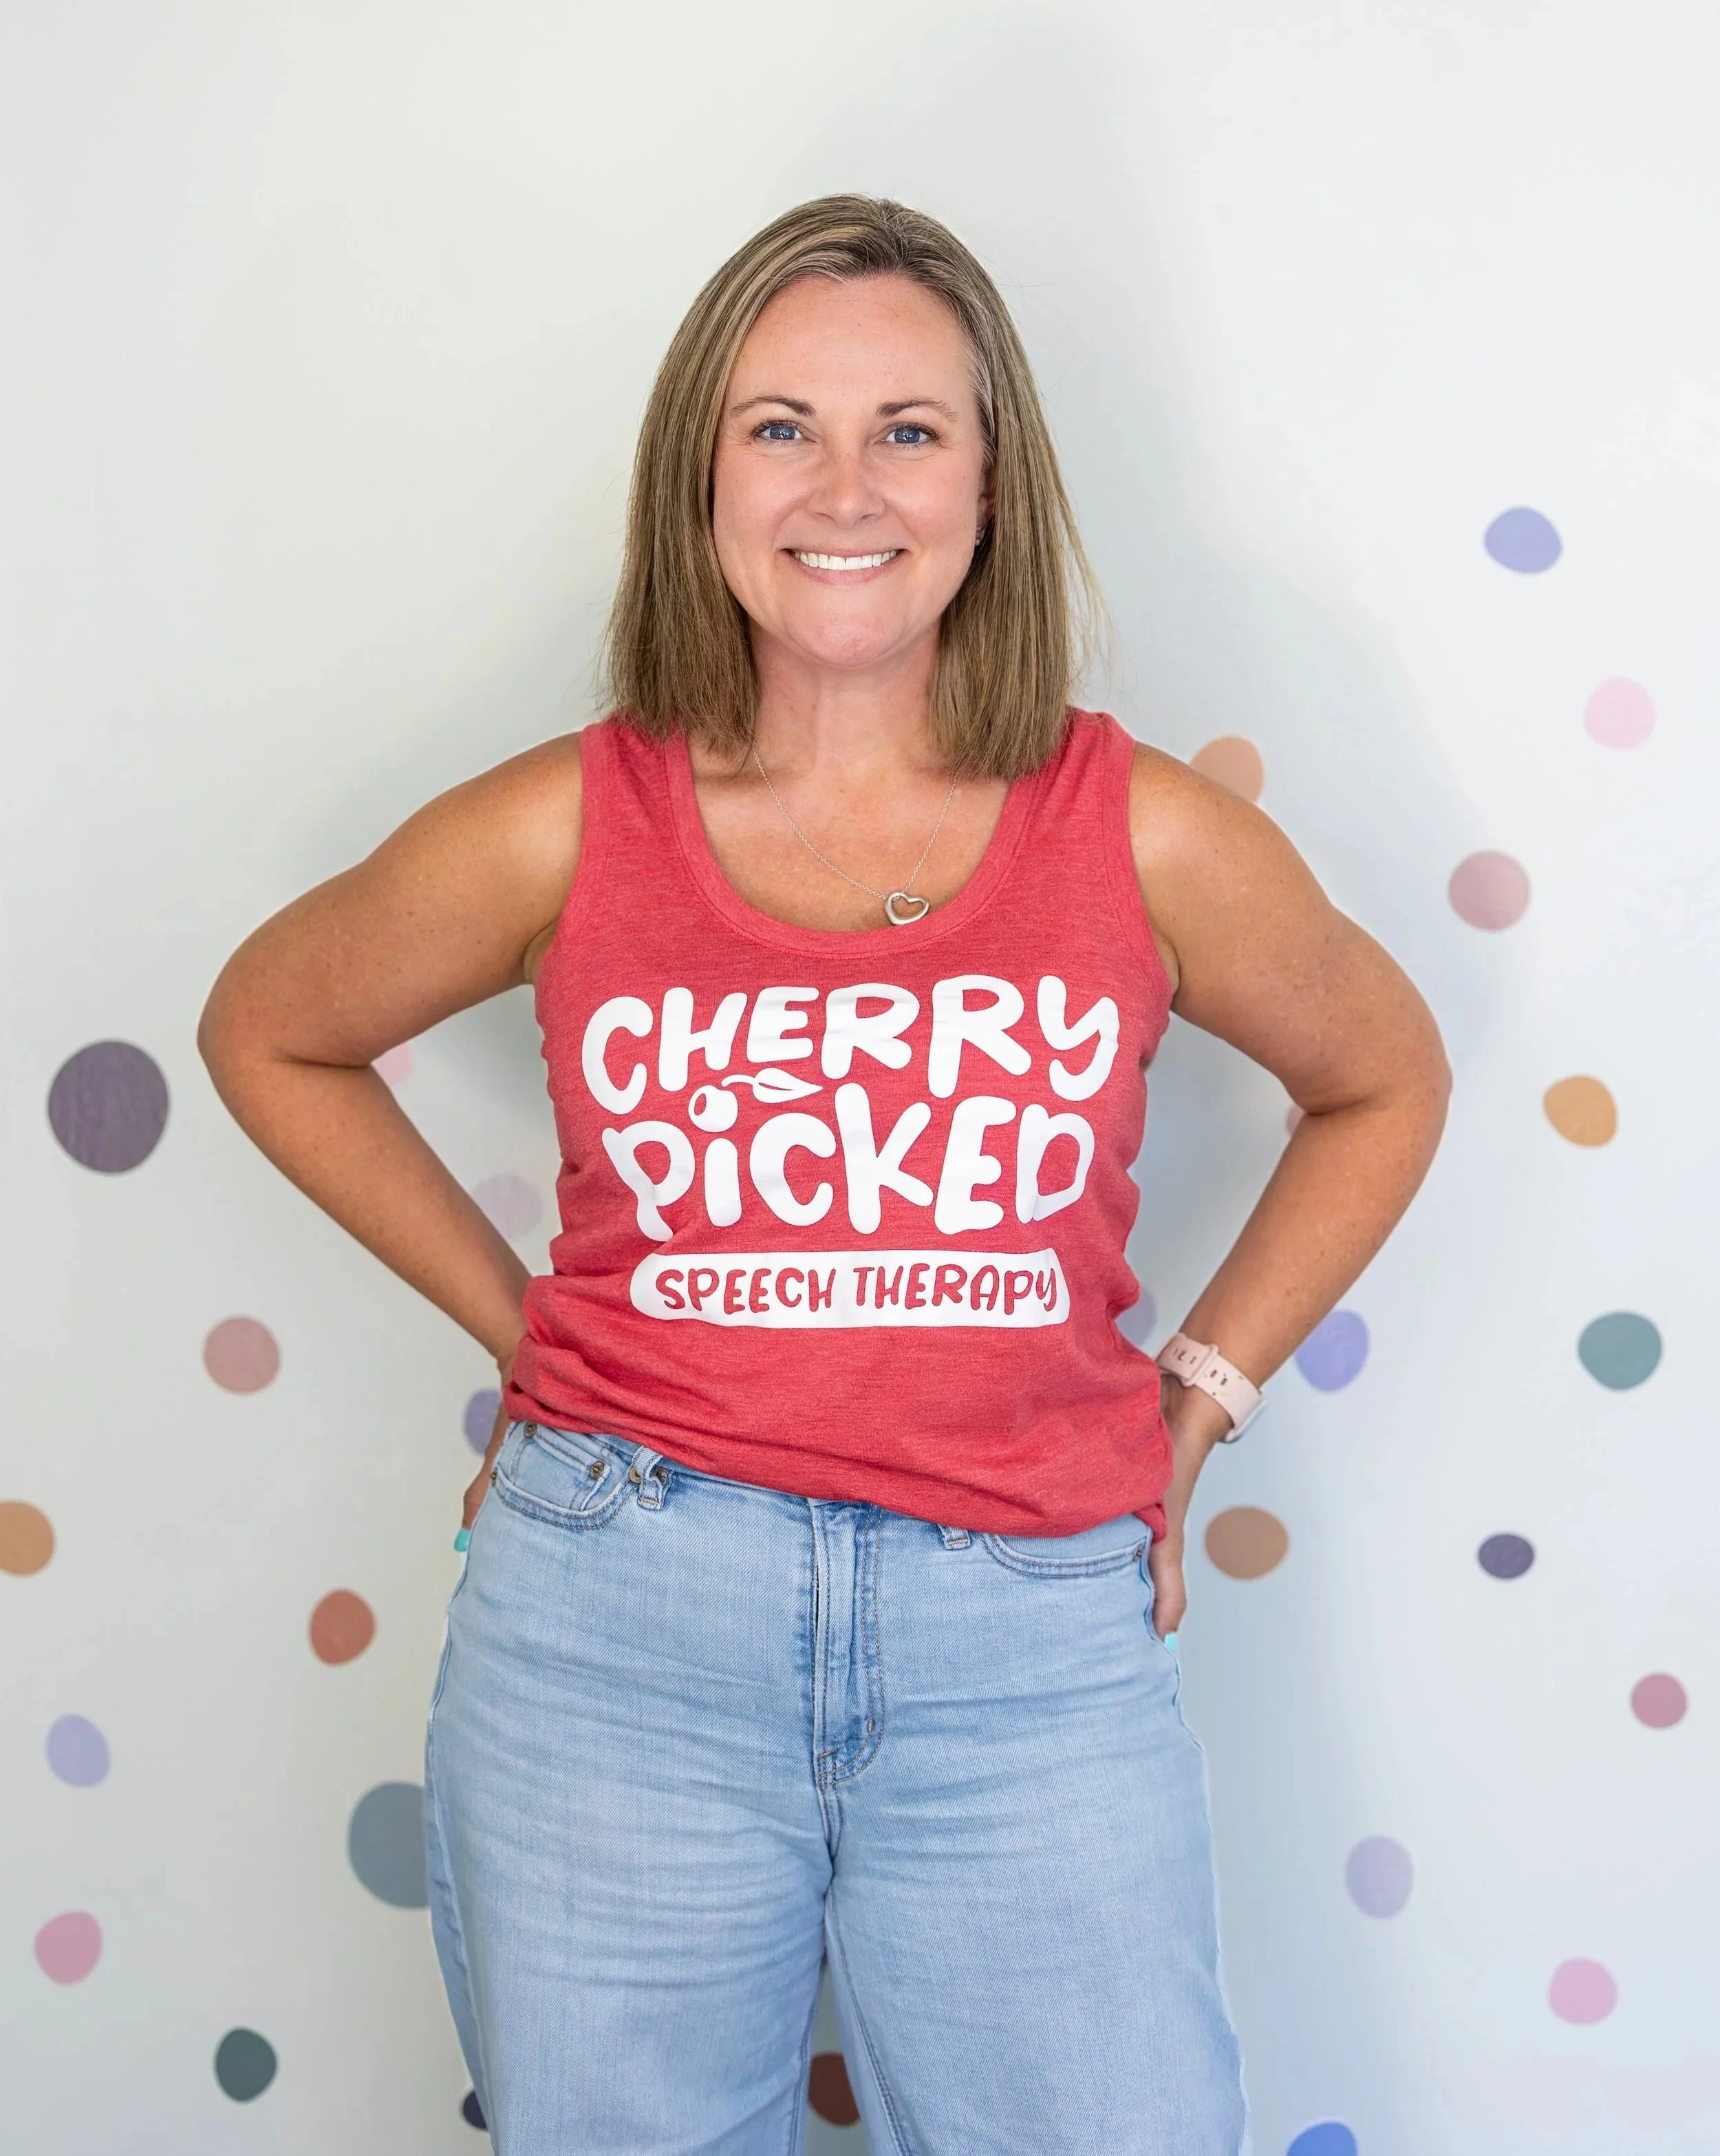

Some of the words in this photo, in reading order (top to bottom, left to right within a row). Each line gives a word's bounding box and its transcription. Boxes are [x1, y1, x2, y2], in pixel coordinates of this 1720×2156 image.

[582, 974, 1121, 1114] CHERRY
[656, 1268, 837, 1314] SPEECH
[854, 1263, 1057, 1315] THERAPY
